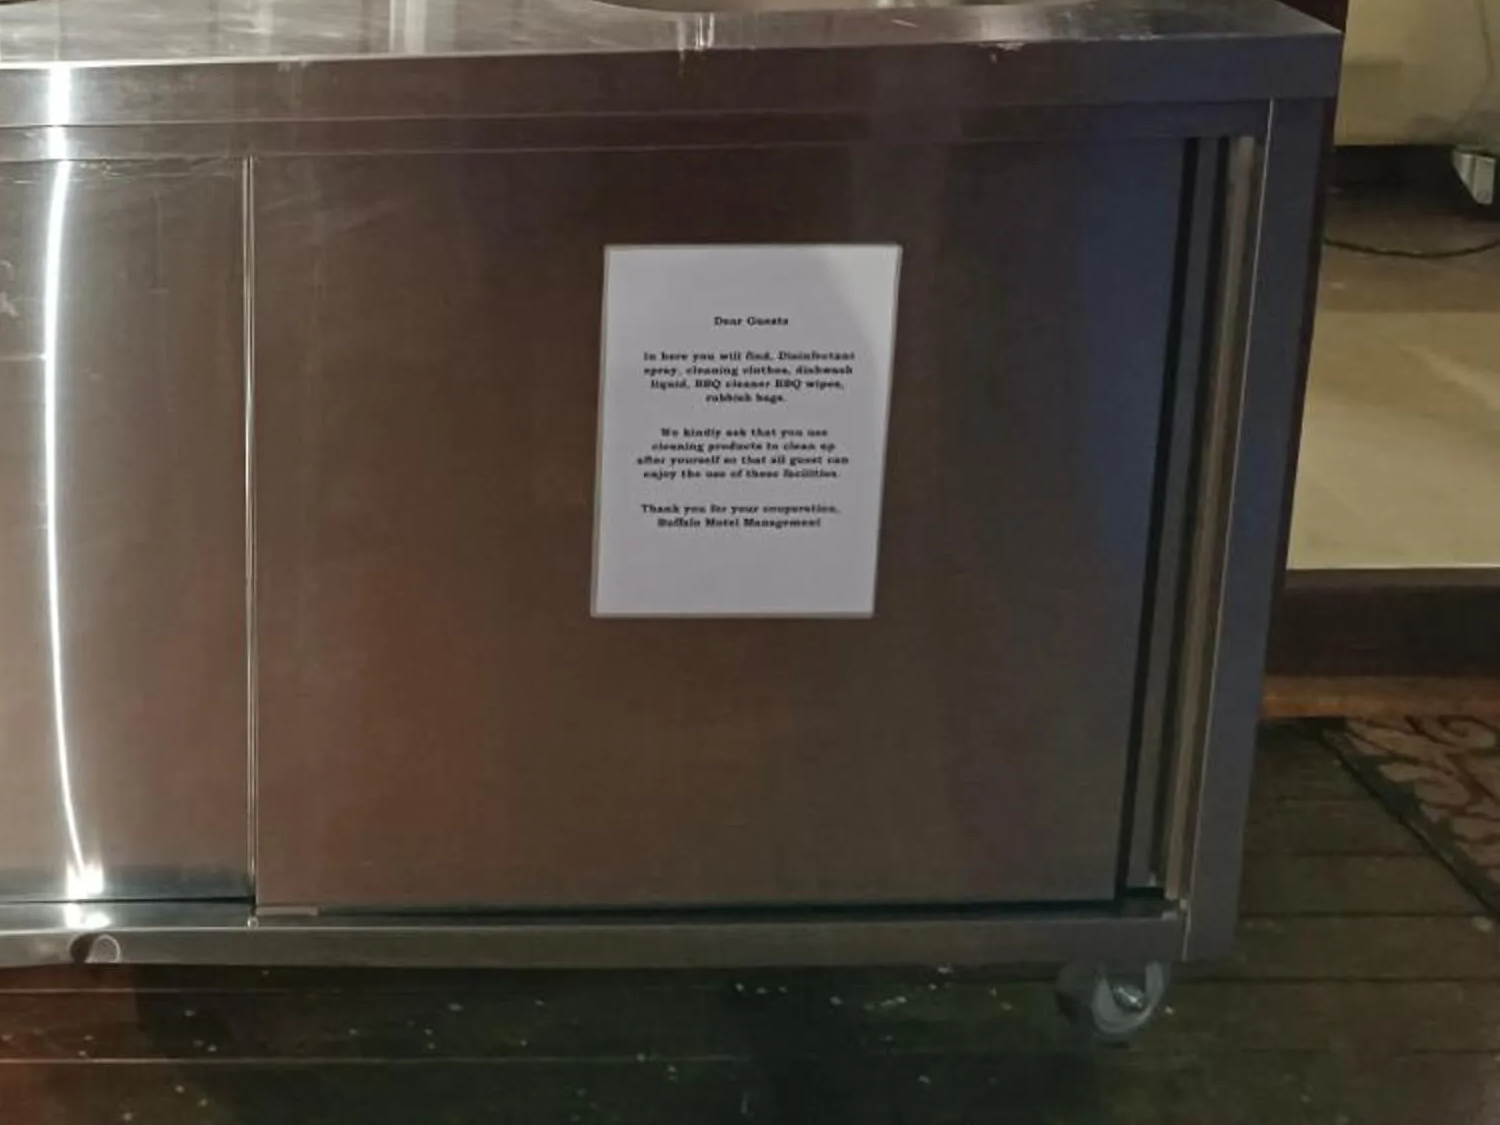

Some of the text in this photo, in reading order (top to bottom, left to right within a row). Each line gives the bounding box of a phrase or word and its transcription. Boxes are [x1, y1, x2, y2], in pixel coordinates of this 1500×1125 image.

[714, 316, 789, 326] Dear Guests
[660, 351, 689, 361] here
[691, 353, 716, 363] you
[719, 351, 742, 361] will
[777, 350, 856, 361] Disinfectant
[685, 365, 739, 377] cleaning
[694, 379, 722, 391] BBQ
[725, 379, 771, 388] cleaner
[774, 379, 803, 390] BBQ
[705, 393, 753, 403] rubbish
[661, 428, 828, 439] We kindly ask that you use
[651, 441, 836, 453] cleaning products to clean up
[636, 455, 667, 465] after
[669, 455, 721, 466] yourself
[741, 455, 767, 465] that
[769, 455, 787, 465] all
[643, 470, 679, 481] enjoy
[681, 469, 702, 478] the
[729, 469, 743, 478] of
[745, 469, 780, 478] these
[641, 504, 681, 514] Thank
[684, 506, 707, 516] you
[710, 503, 727, 513] for
[730, 506, 759, 515] your
[657, 517, 821, 529] Buffalo Motel Management
